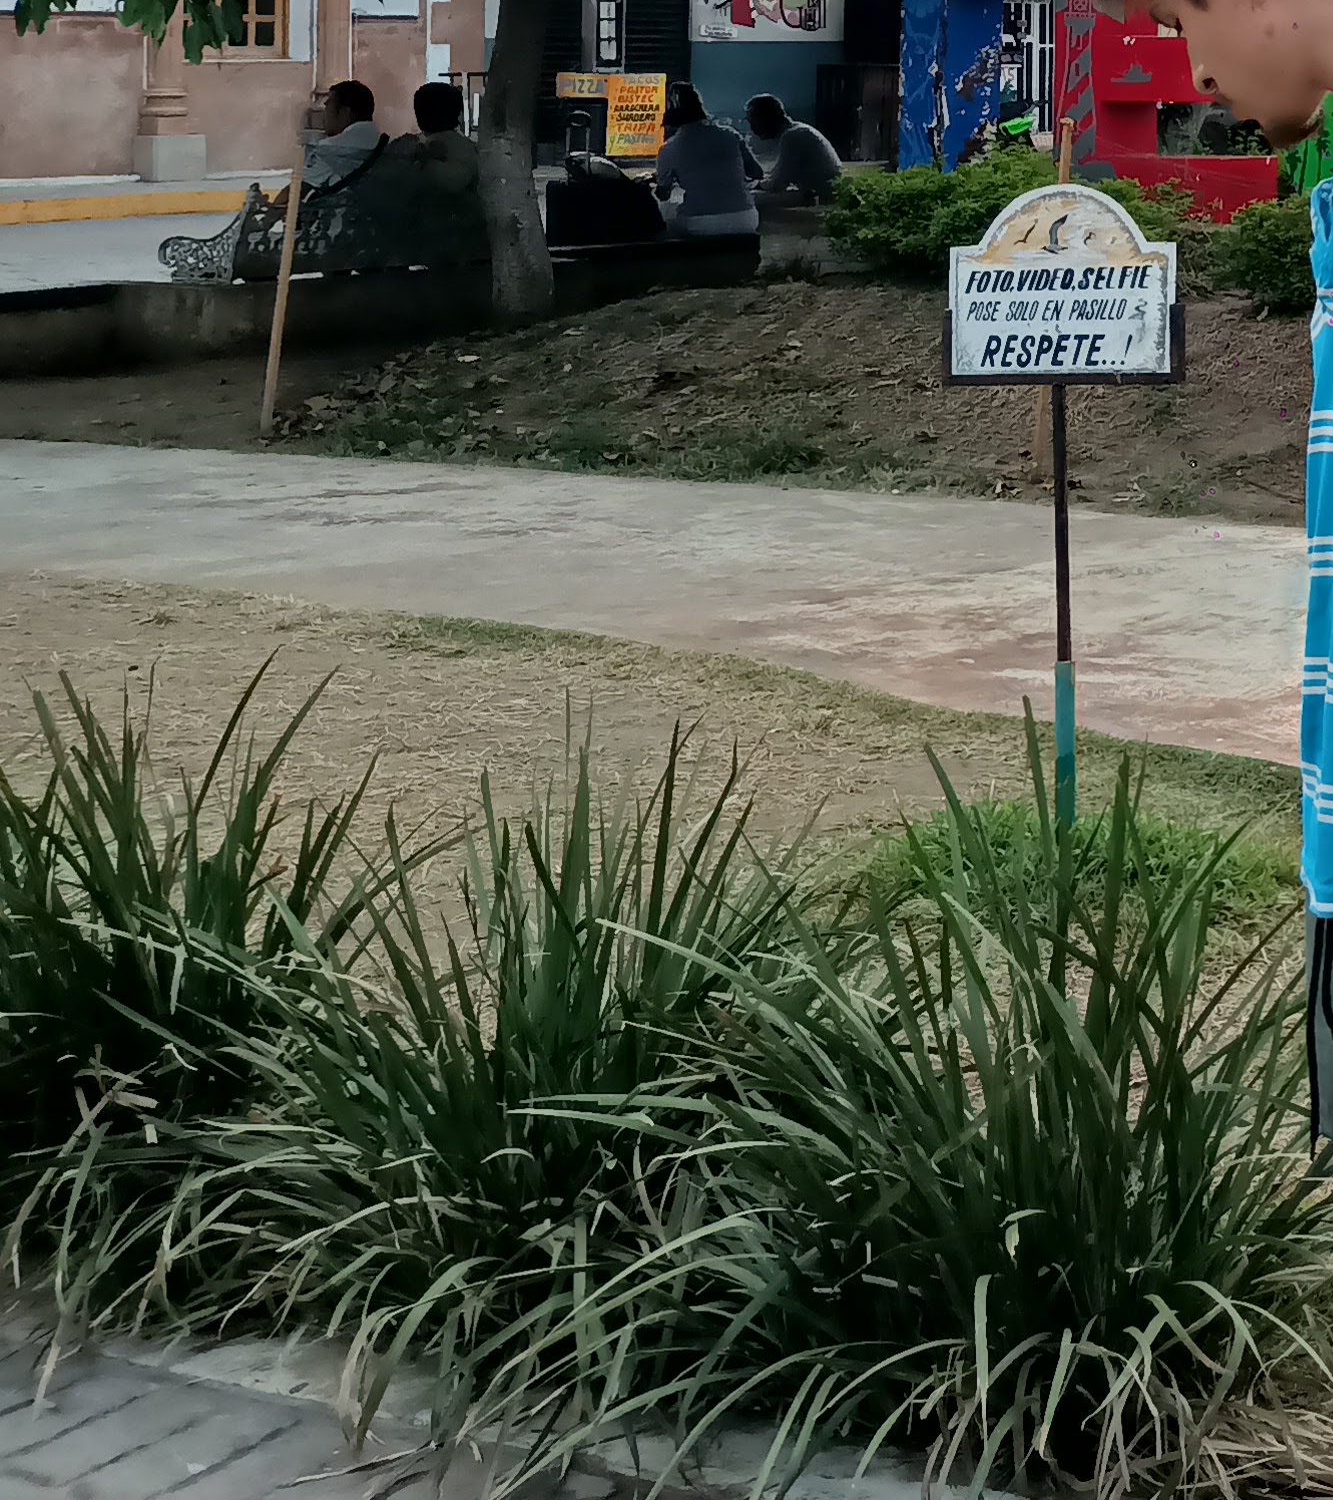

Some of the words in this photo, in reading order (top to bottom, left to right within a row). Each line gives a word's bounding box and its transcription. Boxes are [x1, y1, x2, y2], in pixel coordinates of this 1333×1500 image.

[966, 300, 1001, 322] POSE
[1005, 300, 1039, 322] SOLO
[1042, 299, 1065, 321] EN
[1068, 298, 1128, 321] PASILLO
